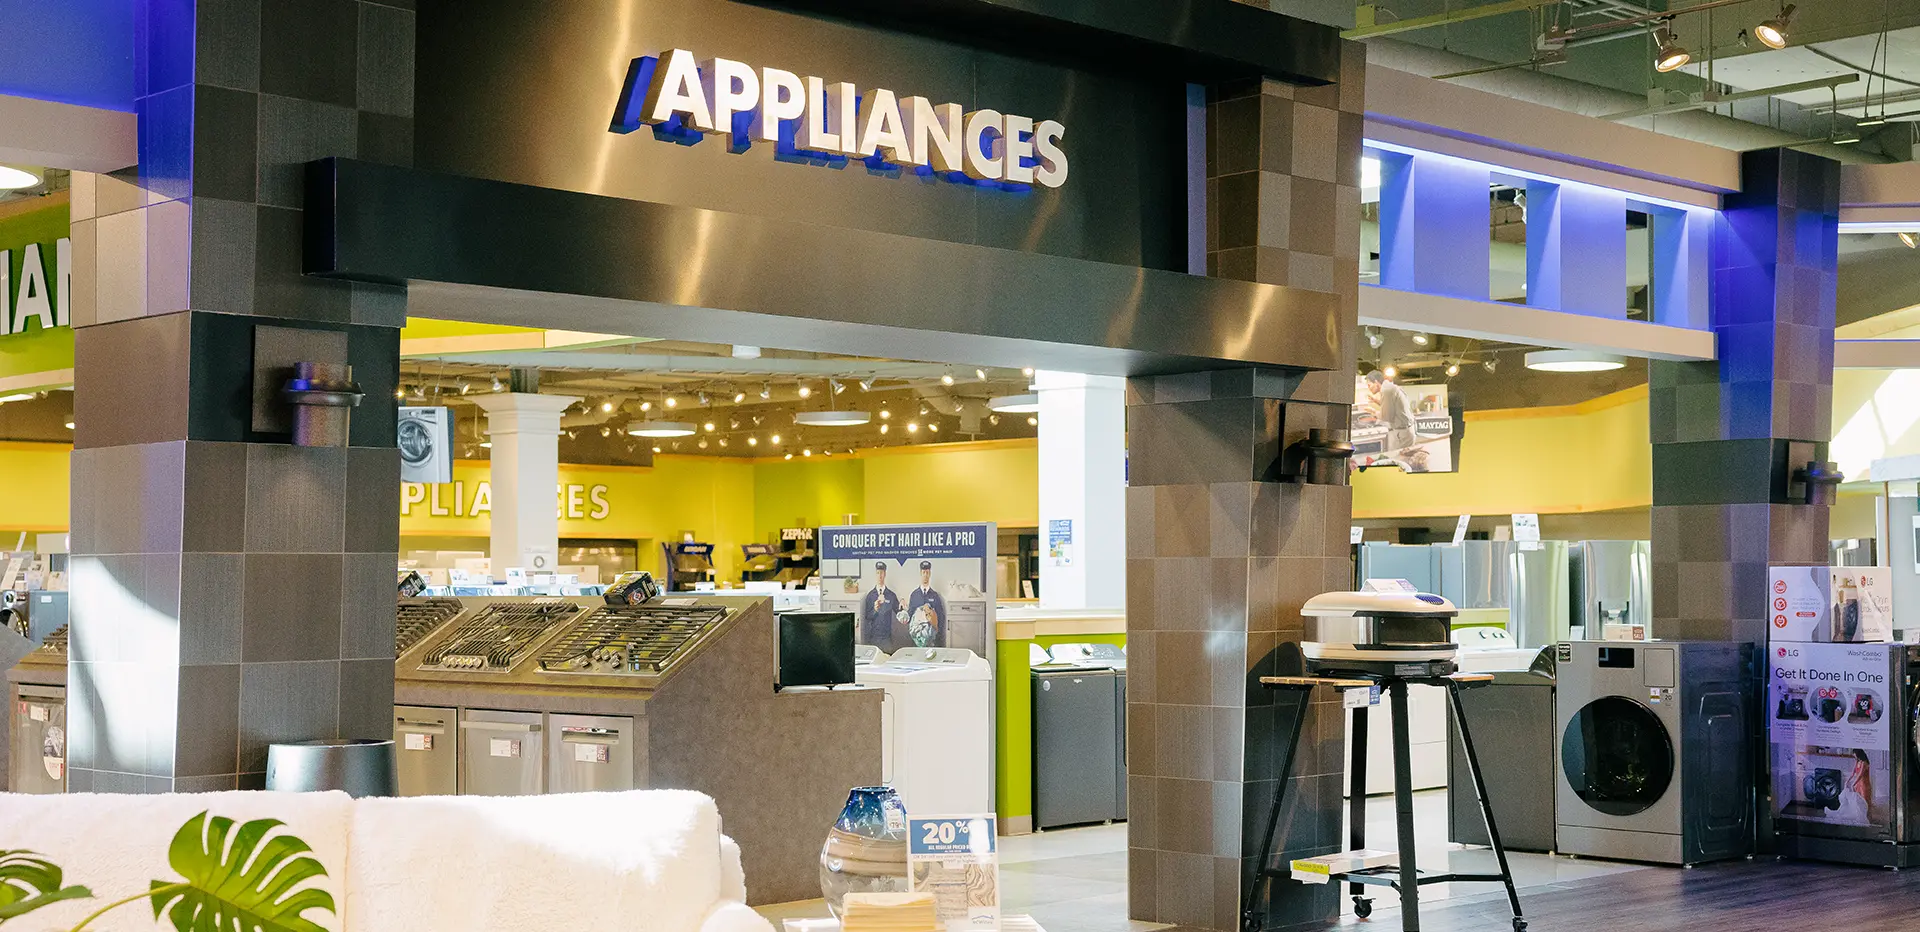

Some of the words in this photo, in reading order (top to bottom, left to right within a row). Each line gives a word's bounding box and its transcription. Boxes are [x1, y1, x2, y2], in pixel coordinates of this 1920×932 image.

[650, 48, 1068, 188] APPLIANCES
[1418, 421, 1449, 429] MAYTAG
[832, 533, 876, 549] CONQUER
[879, 533, 896, 547] PET
[898, 532, 920, 547] HAIR
[923, 532, 944, 547] LIKE
[946, 532, 953, 546] A
[955, 531, 975, 546] PRO
[1866, 577, 1873, 586] LG
[1788, 649, 1799, 657] LG
[1775, 667, 1796, 679] Get
[1799, 669, 1806, 680] It
[1809, 669, 1841, 681] Done
[1844, 670, 1854, 682] In
[1857, 671, 1883, 683] One
[922, 821, 969, 844] 20%
